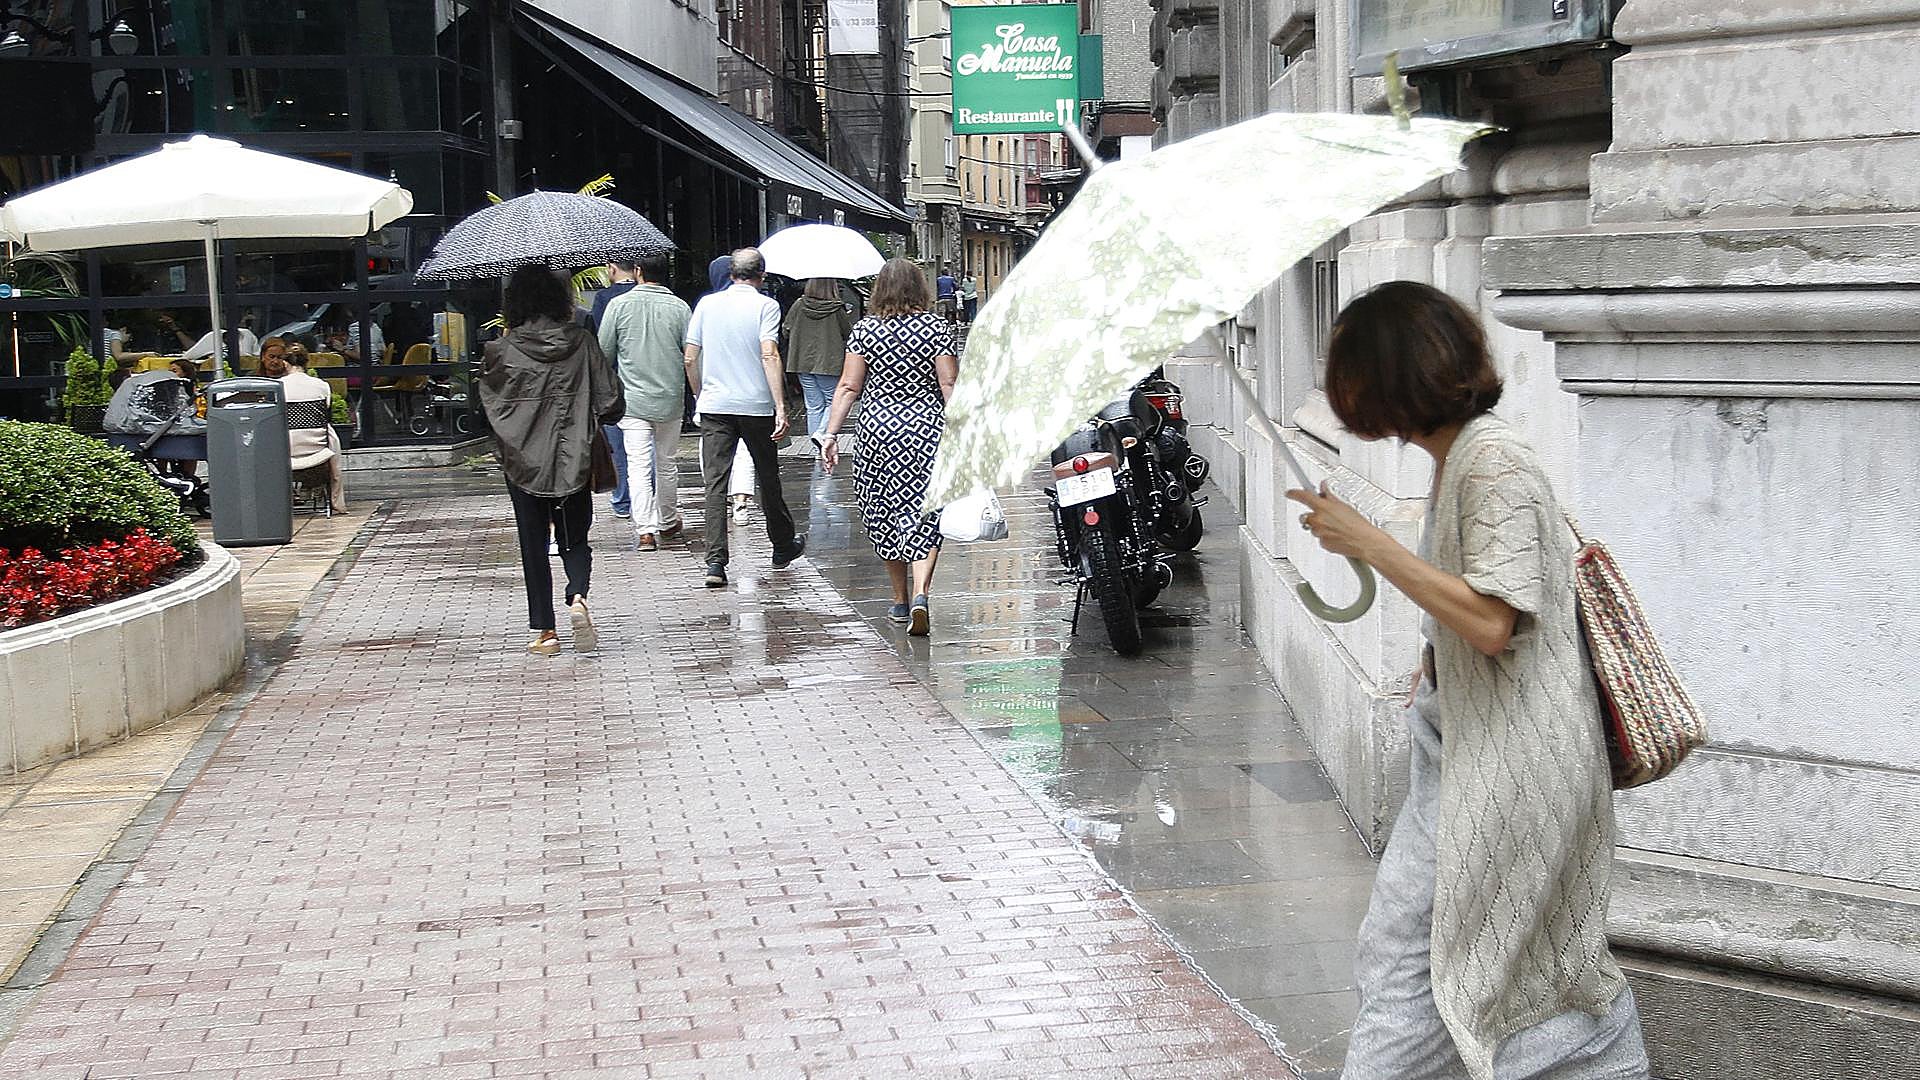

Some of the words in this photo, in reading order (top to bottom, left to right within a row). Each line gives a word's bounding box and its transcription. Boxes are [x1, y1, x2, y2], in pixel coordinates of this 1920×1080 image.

[995, 23, 1058, 54] Casa
[956, 44, 1073, 76] Manuela
[958, 108, 1055, 125] Restaurante
